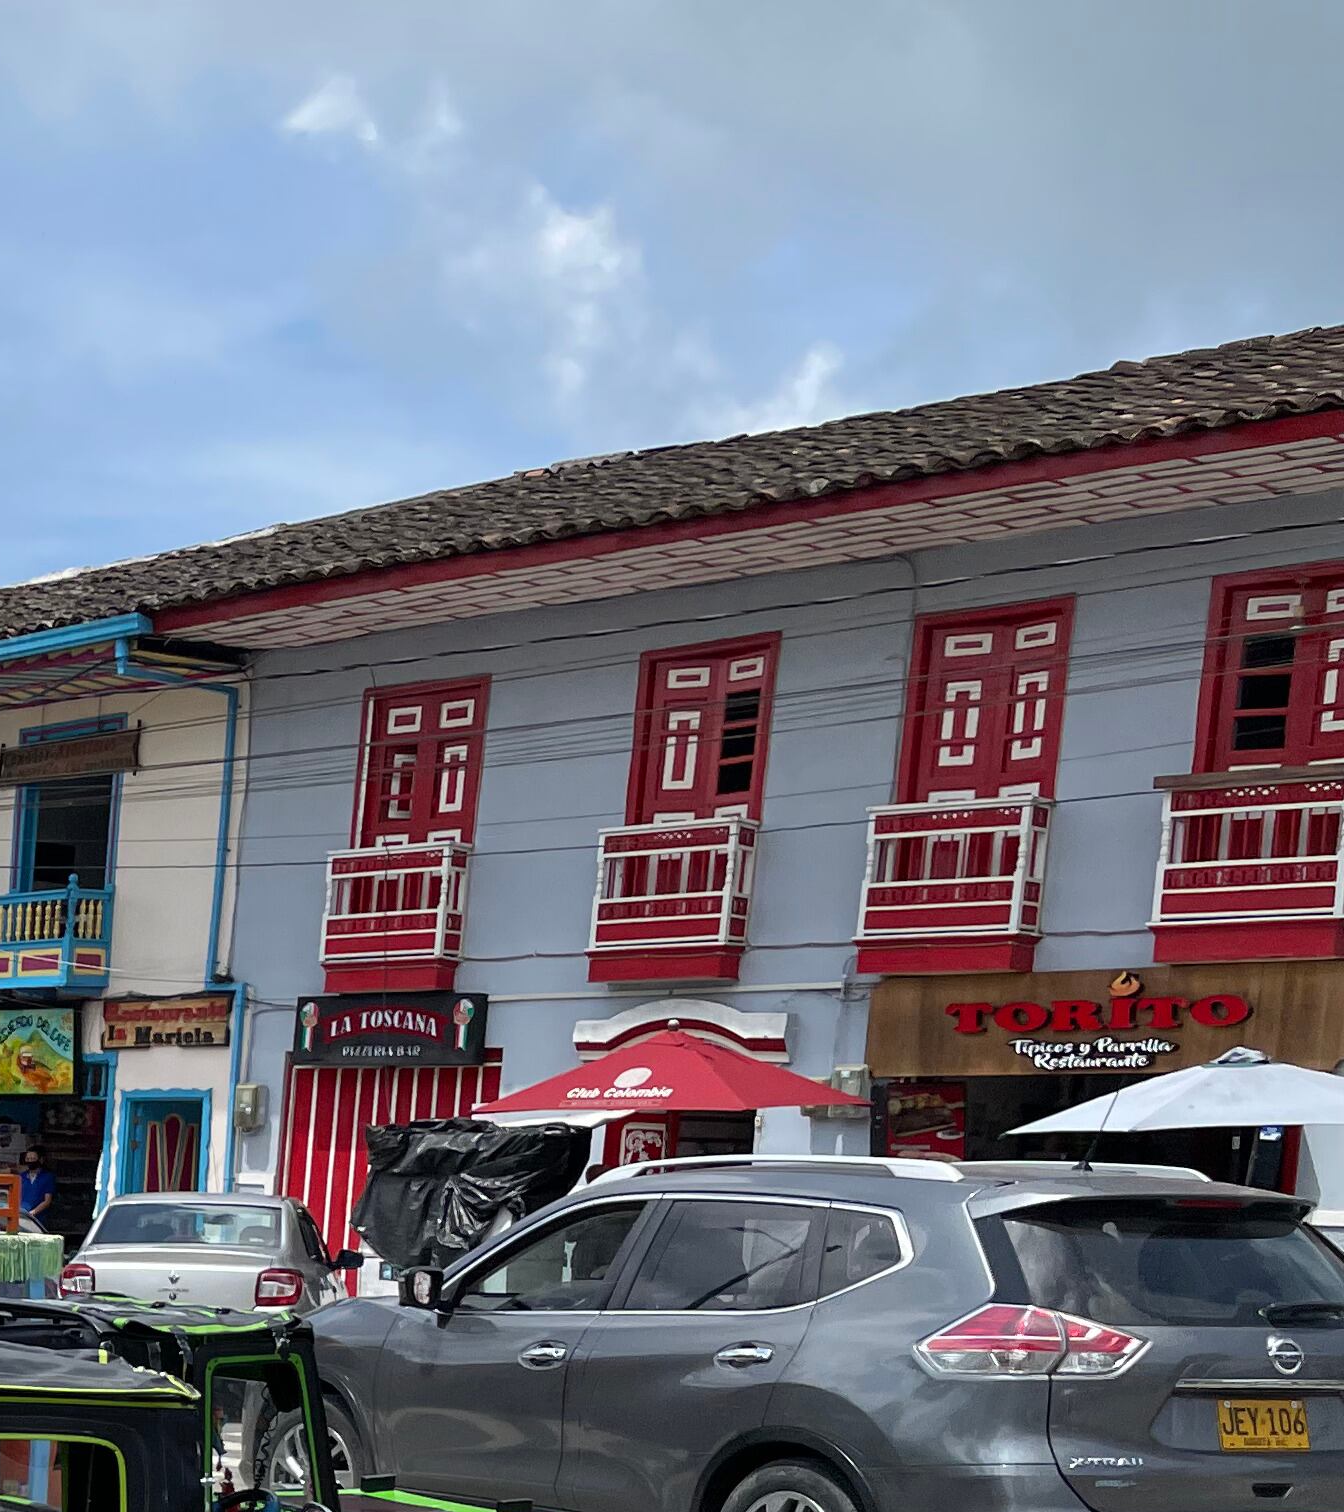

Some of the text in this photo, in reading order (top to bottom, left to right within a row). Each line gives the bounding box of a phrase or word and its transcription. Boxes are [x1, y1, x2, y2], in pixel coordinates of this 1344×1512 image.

[330, 1009, 438, 1037] LA TOSCANA
[945, 994, 1250, 1034] TORITO
[1079, 1042, 1092, 1056] y
[1093, 1036, 1175, 1053] Parrilla
[1033, 1053, 1150, 1070] Restaurante
[566, 1087, 674, 1098] Club Colombia
[1222, 1407, 1306, 1436] JEY 106
